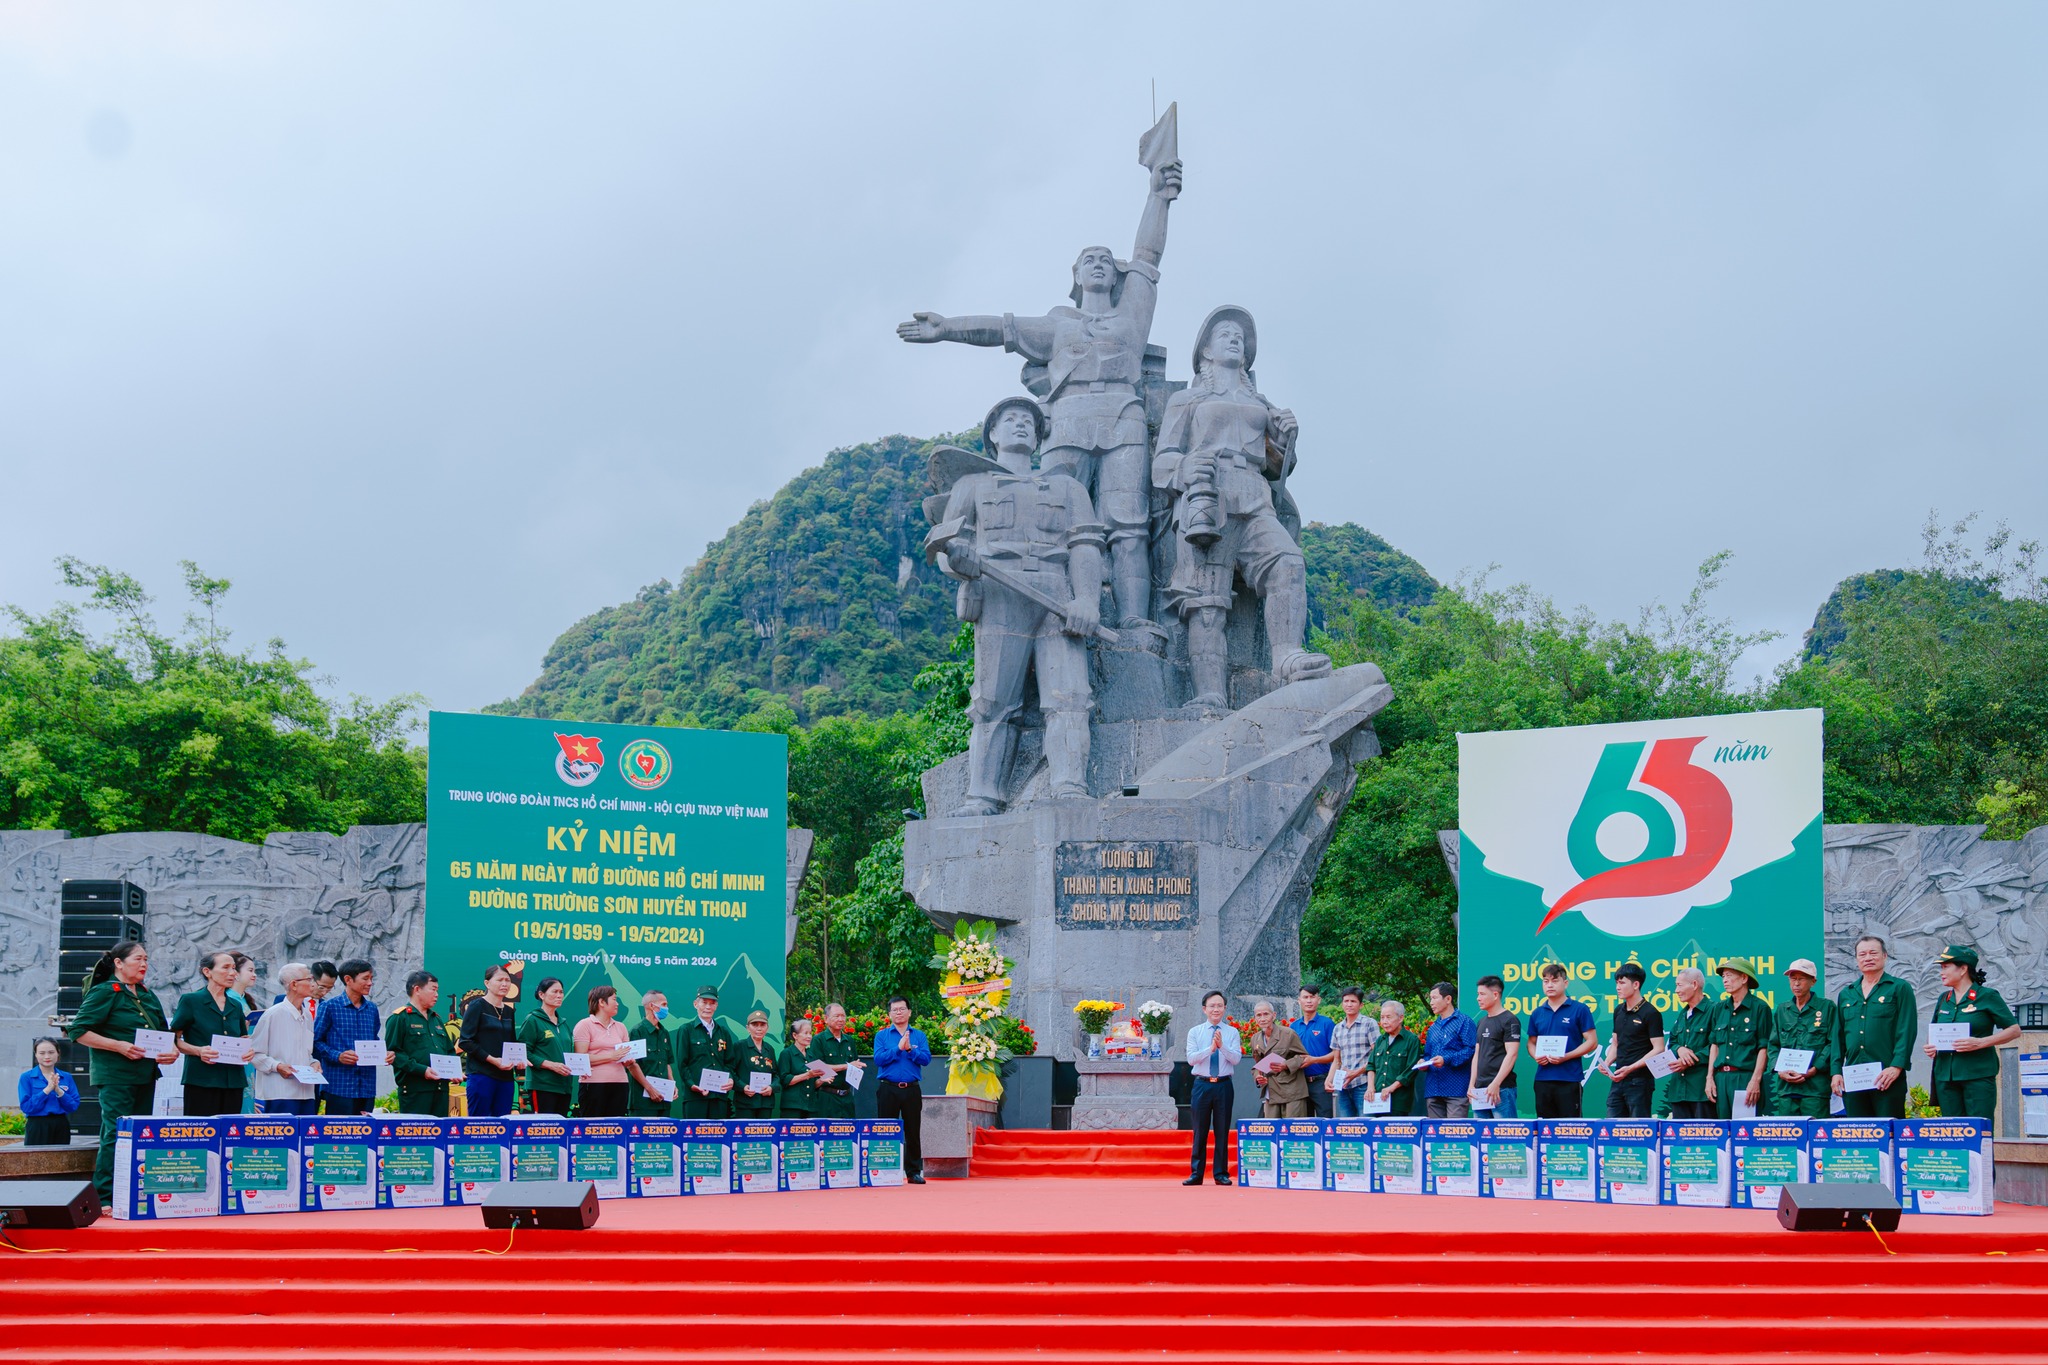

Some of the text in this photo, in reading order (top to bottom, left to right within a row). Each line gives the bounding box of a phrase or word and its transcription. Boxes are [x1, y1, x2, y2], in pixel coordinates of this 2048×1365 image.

[1714, 740, 1773, 763] năm
[449, 789, 484, 802] TRUNG
[486, 790, 518, 804] ƯƠNG
[520, 792, 550, 806] ĐOÀN
[553, 796, 579, 808] TNCS
[581, 793, 597, 809] HỒ
[600, 797, 618, 810] CHÍ
[620, 800, 646, 812] MINH
[654, 800, 672, 816] HỘI
[674, 802, 696, 817] CỰU
[698, 804, 722, 816] TNXP
[725, 804, 744, 819] VIỆT
[746, 807, 768, 818] NAM
[547, 819, 676, 862] KỶ NIỆM
[1101, 848, 1153, 871] TƯỢNG ĐÀI
[450, 859, 765, 891] 65 NĂM NGÀY MỞ ĐƯỜNG HỒ CHÍ MINH
[1063, 874, 1191, 895] THANH NIÊN XUNG PHONG
[468, 888, 747, 921] ĐƯỜNG TRƯỜNG SƠN HUYỀN THOẠI
[1072, 900, 1181, 922] CHỐNG MỸ CỨU NƯỚC
[514, 921, 603, 941] (19/5/1959
[619, 925, 704, 946] 19/5/2024)
[499, 950, 717, 966] Quảng Bình, ngày 17 tháng 5 năm 2024
[159, 1126, 216, 1138] SENKO
[244, 1126, 295, 1137] SENKO
[323, 1125, 372, 1136] SENKO
[395, 1126, 442, 1136] SENKO
[463, 1125, 506, 1135] SENKO
[527, 1126, 565, 1136] SENKO
[585, 1126, 623, 1135] SENKO
[642, 1126, 678, 1135] SENKO
[695, 1126, 727, 1135] SENKO
[744, 1126, 776, 1135] SENKO
[790, 1126, 818, 1134] SENKO
[828, 1125, 856, 1133] SENKO
[872, 1125, 901, 1133] SENKO
[1248, 1125, 1275, 1134] SENKO
[1290, 1125, 1320, 1134] SENKO
[1336, 1126, 1368, 1134] SENKO
[1384, 1126, 1418, 1135] SENKO
[1438, 1126, 1476, 1135] SENKO
[1494, 1127, 1530, 1136] SENKO
[1554, 1127, 1593, 1136] SENKO
[1612, 1127, 1653, 1137] SENKO
[1679, 1127, 1723, 1137] SENKO
[1753, 1127, 1803, 1137] SENKO
[1832, 1128, 1885, 1138] SENKO
[1919, 1127, 1976, 1138] SENKO
